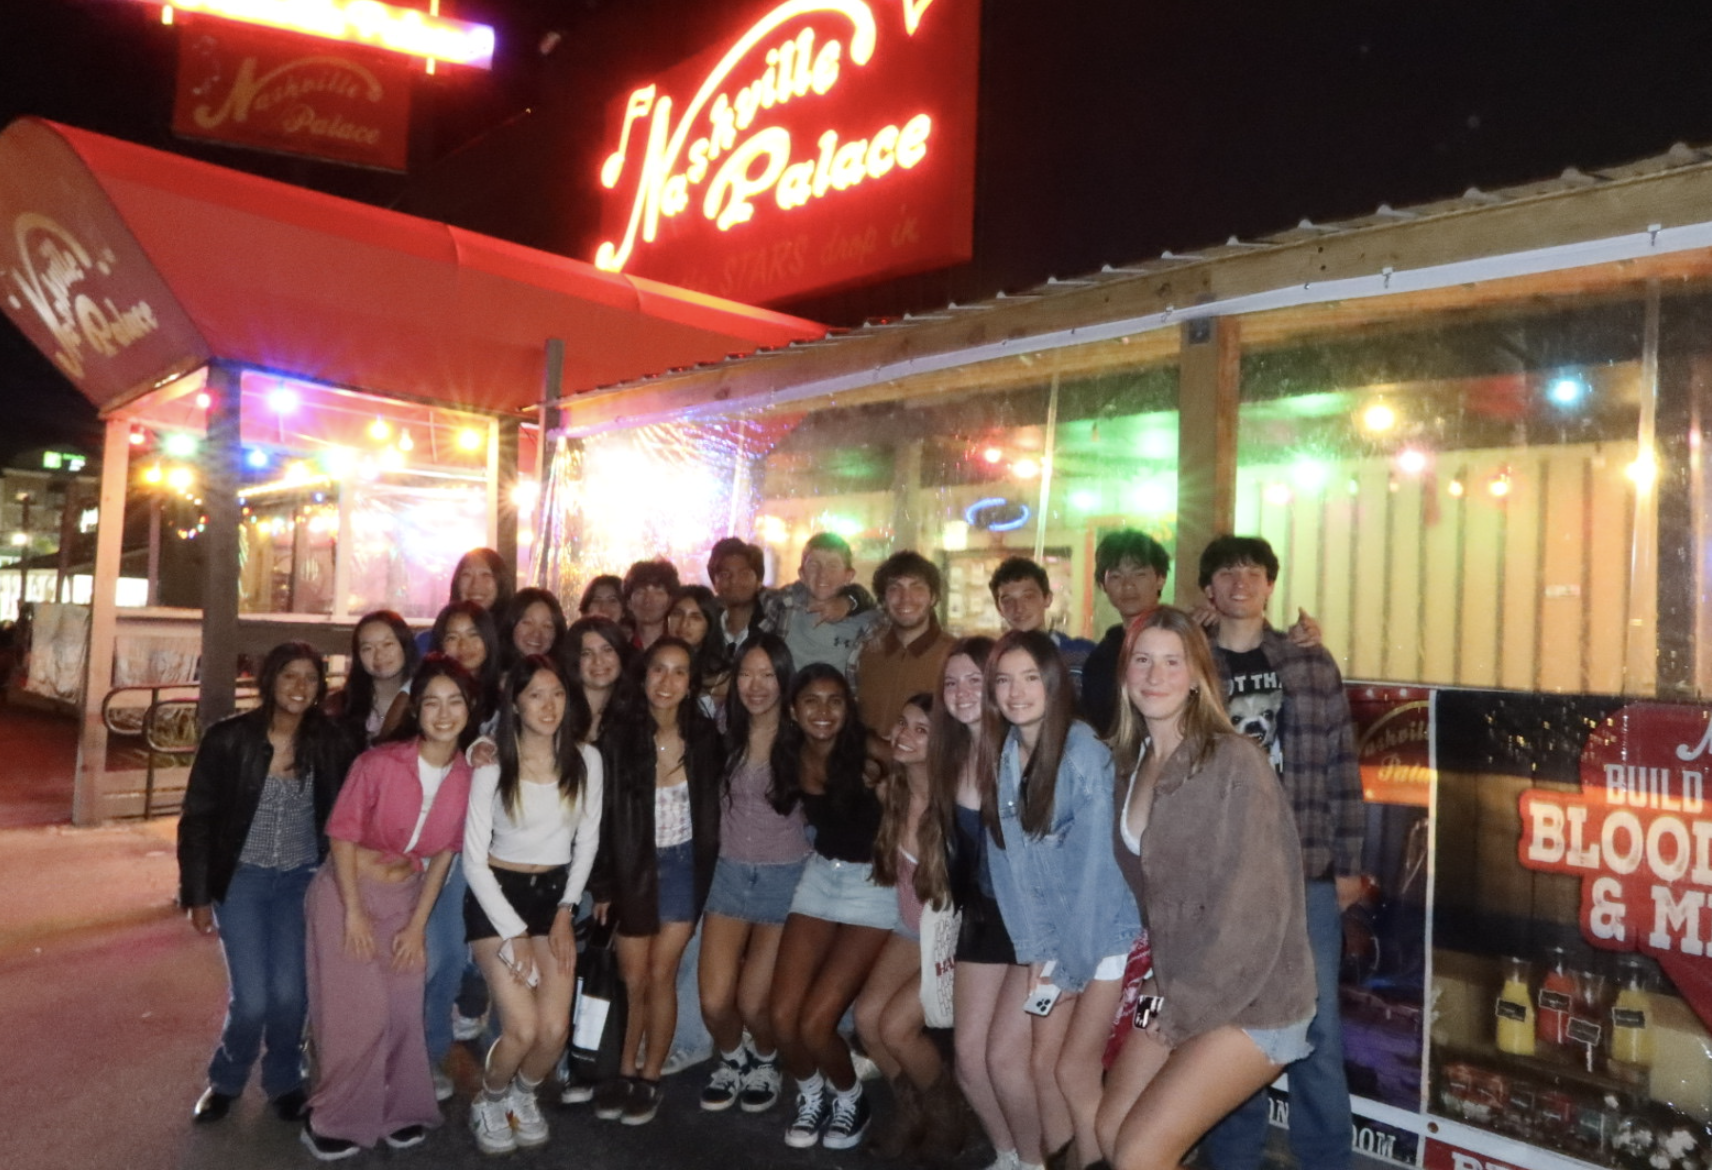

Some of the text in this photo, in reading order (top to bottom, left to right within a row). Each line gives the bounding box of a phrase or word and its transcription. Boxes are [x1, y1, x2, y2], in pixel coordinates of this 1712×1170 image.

[193, 56, 384, 129] Nashville
[282, 104, 381, 145] Palace
[596, 0, 877, 273] Nashville
[703, 113, 932, 231] Palace
[718, 232, 809, 297] STARS
[819, 224, 878, 268] drop
[1605, 764, 1704, 814] BUILD
[1589, 876, 1712, 957] & M
